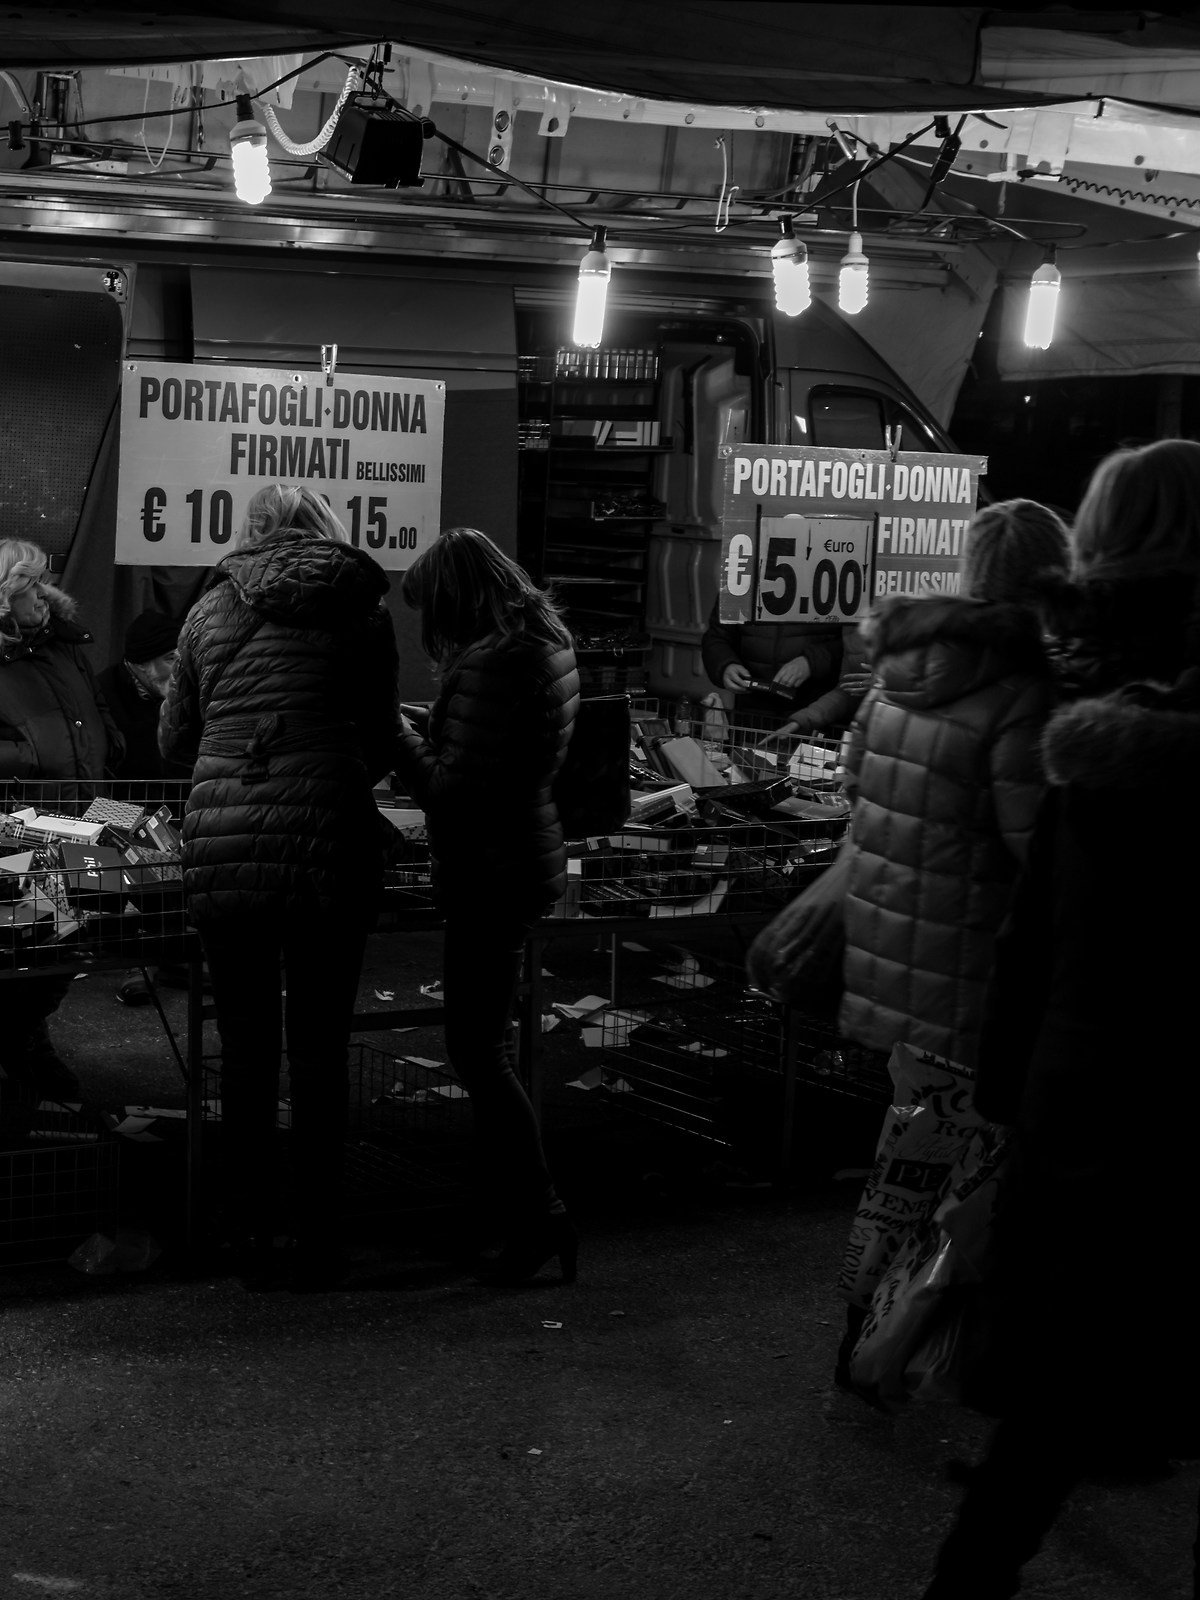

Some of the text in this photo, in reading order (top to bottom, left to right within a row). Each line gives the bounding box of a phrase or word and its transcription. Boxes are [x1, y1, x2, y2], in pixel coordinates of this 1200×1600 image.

[139, 376, 427, 434] PORTAFOGLI DONNA
[230, 433, 350, 480] FIRMATI
[356, 461, 426, 484] BELLISSIMI
[732, 457, 972, 504] PORTAFOGLI DONNA
[823, 539, 855, 553] €uro
[761, 537, 862, 616] 5.00
[875, 570, 961, 597] BELLISSIM
